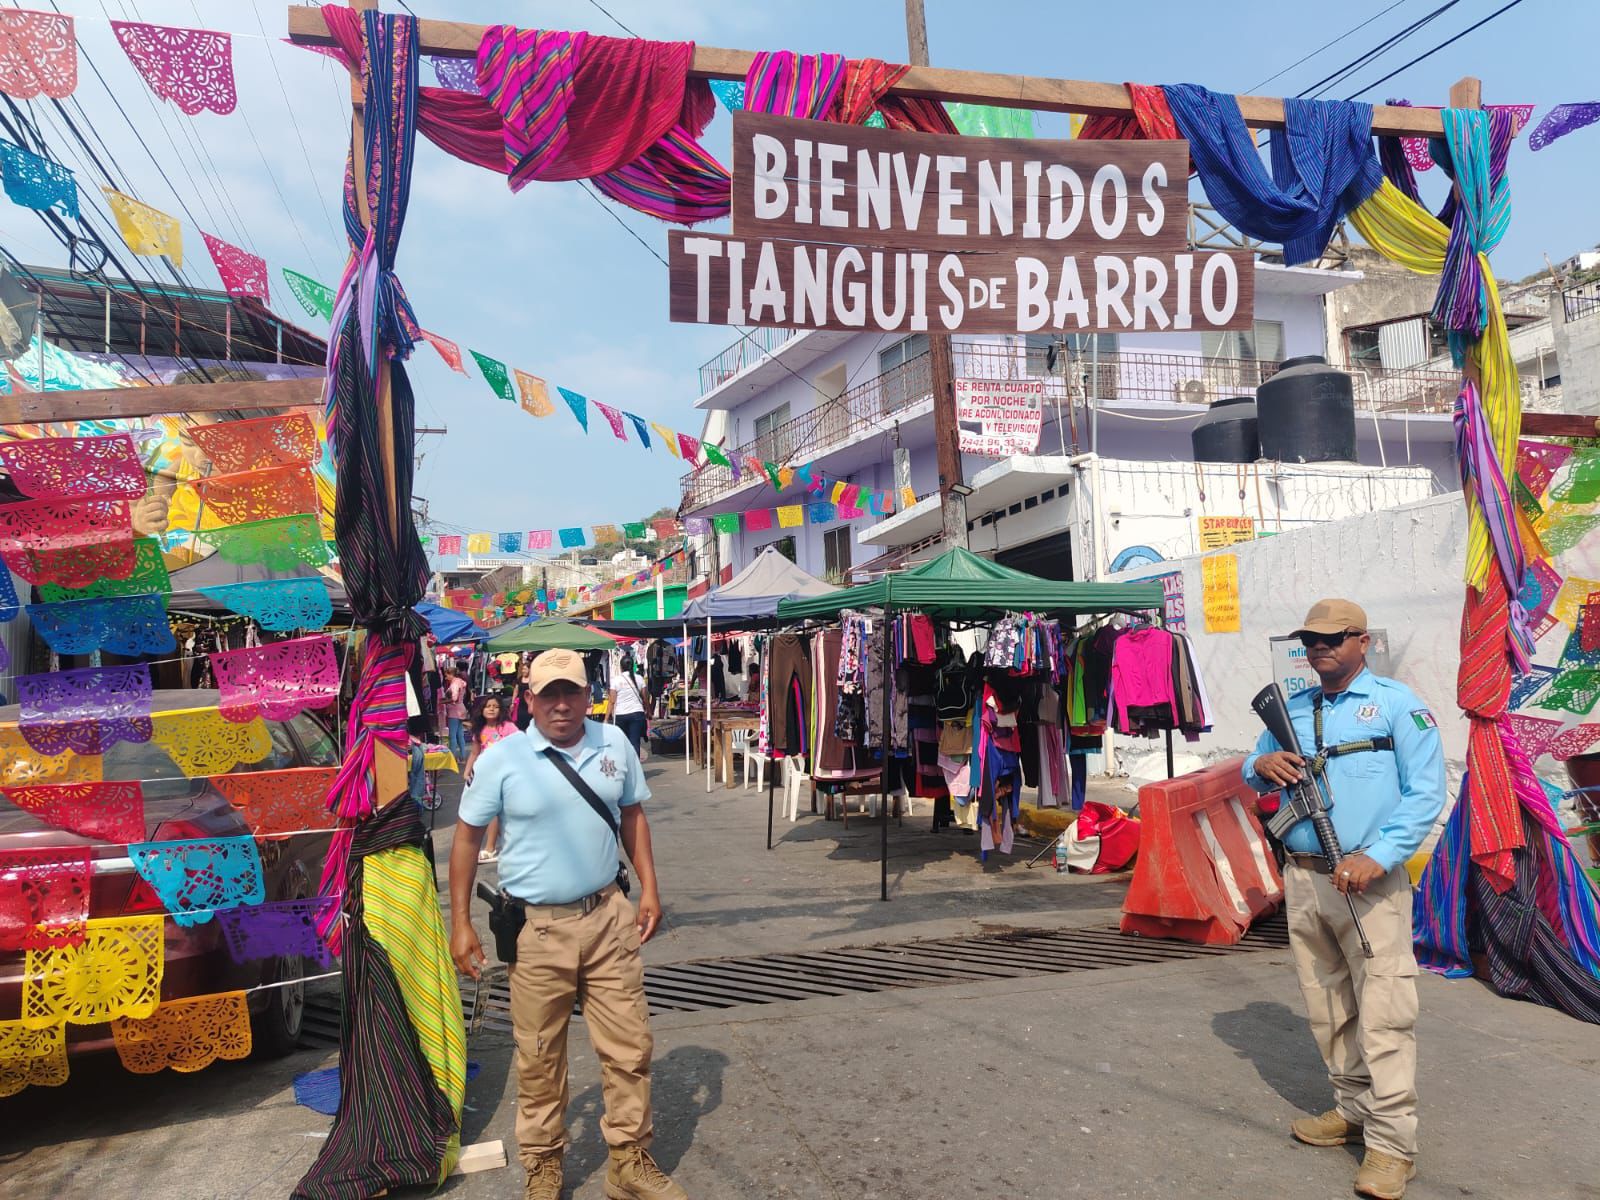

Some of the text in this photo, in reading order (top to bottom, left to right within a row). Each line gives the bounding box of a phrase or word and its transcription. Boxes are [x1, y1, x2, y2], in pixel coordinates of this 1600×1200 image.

[753, 133, 1168, 241] BIENVENIDOS
[684, 237, 1239, 332] TIANGUIS DE BARRIO
[956, 381, 1042, 393] SE RENTA CUARTO
[971, 395, 1026, 406] POR NOCHE
[986, 423, 1039, 433] Y TELEVISION
[1283, 677, 1306, 691] 150
